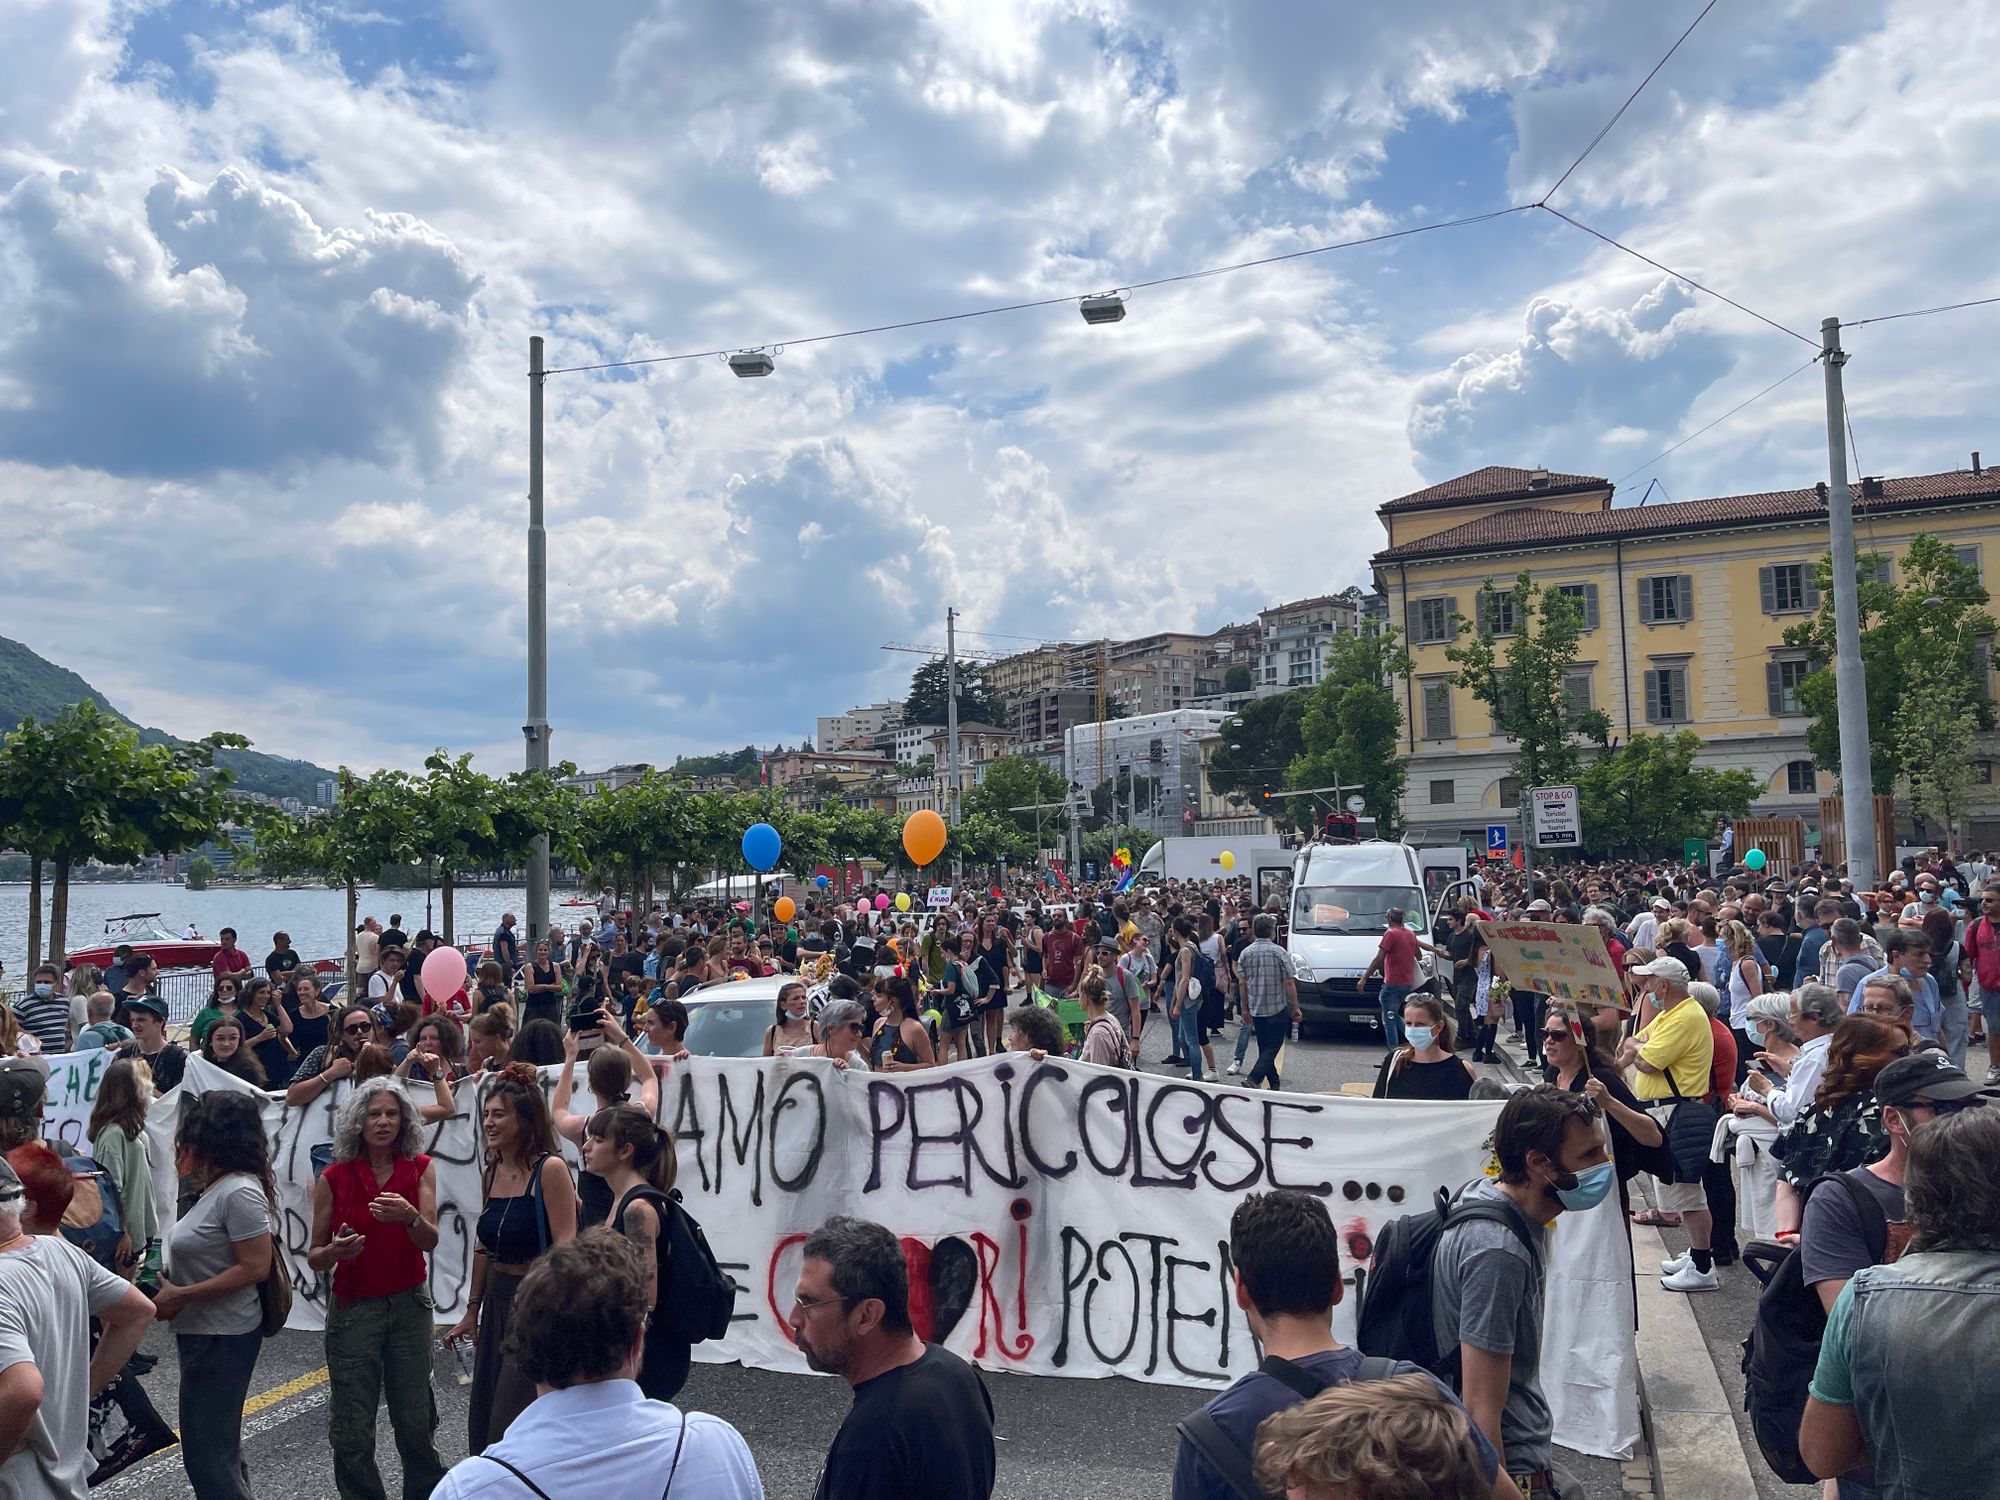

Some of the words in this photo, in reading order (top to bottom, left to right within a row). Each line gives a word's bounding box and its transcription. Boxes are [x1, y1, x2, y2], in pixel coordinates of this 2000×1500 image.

[1536, 792, 1553, 800] STOP
[1554, 792, 1560, 800] &
[1561, 791, 1572, 799] GO
